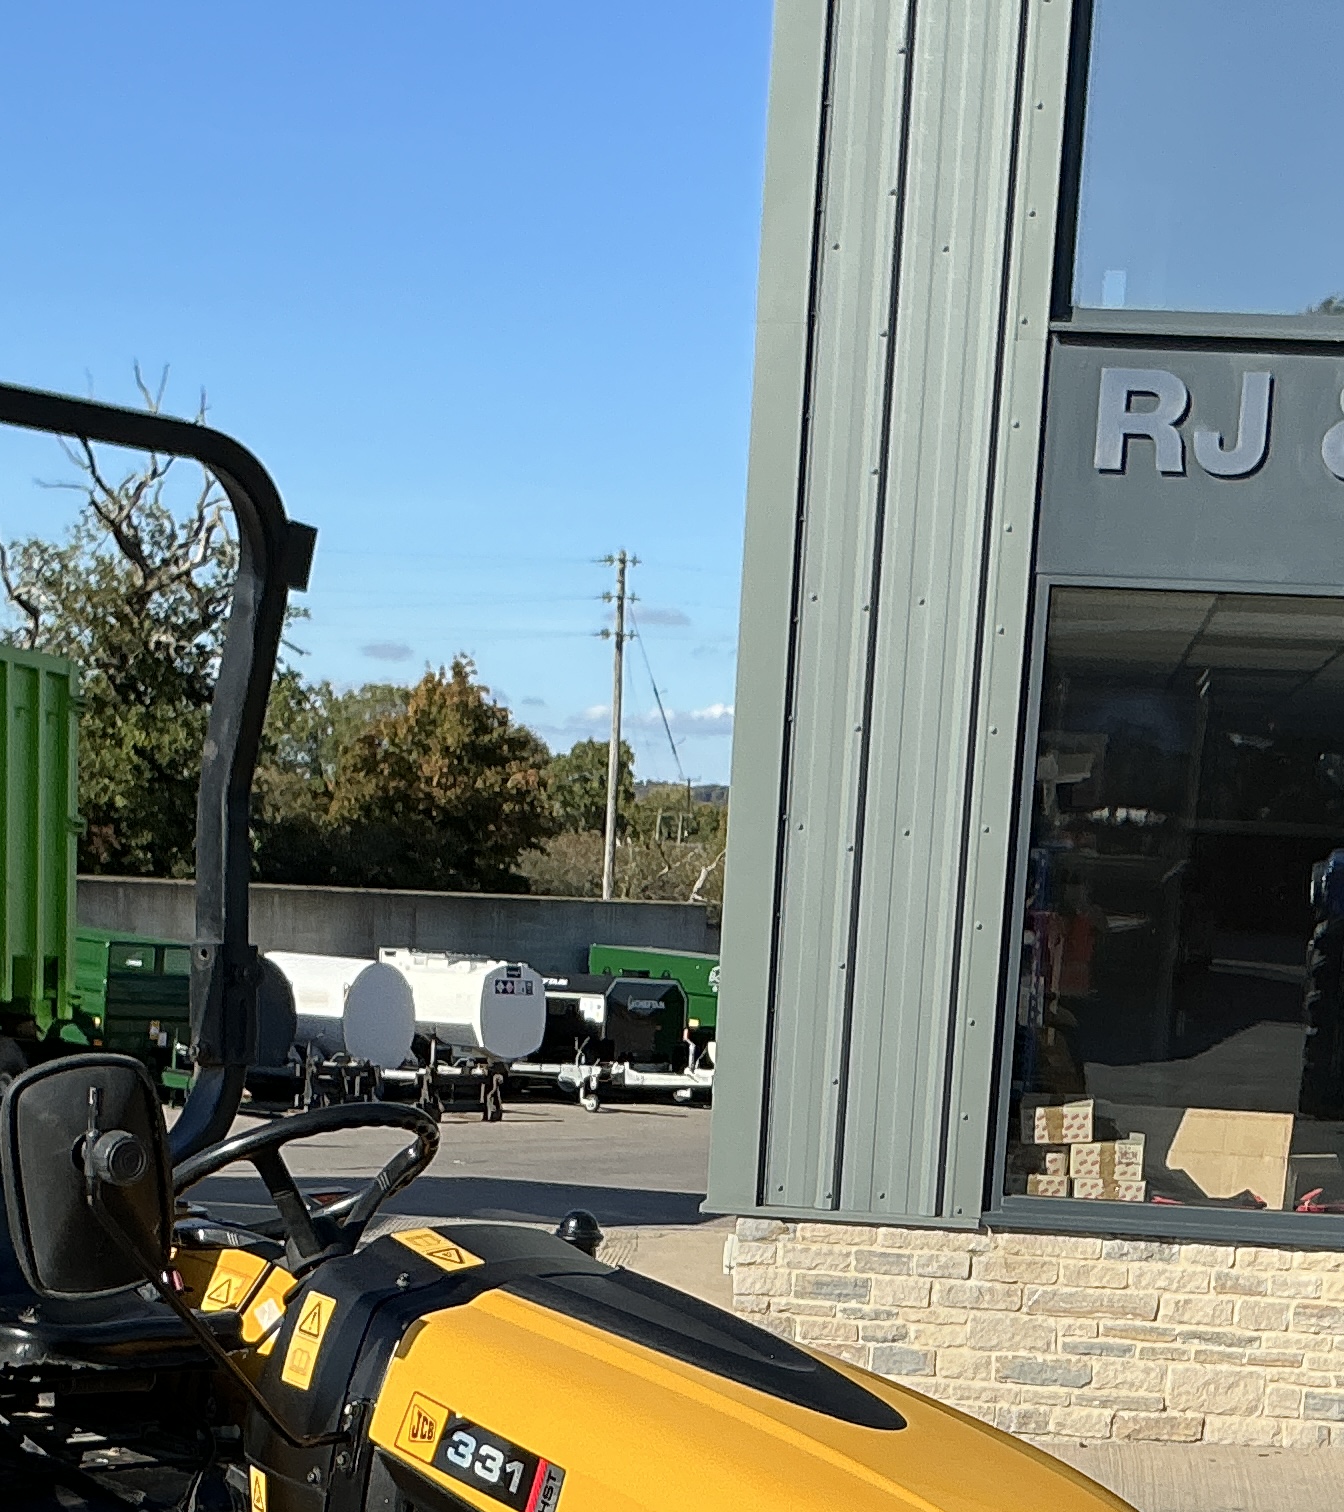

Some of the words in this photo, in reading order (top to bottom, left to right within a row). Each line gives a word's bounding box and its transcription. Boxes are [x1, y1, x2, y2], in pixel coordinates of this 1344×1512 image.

[1093, 366, 1275, 481] RJ
[410, 1410, 435, 1441] JCB
[446, 1430, 525, 1494] 331
